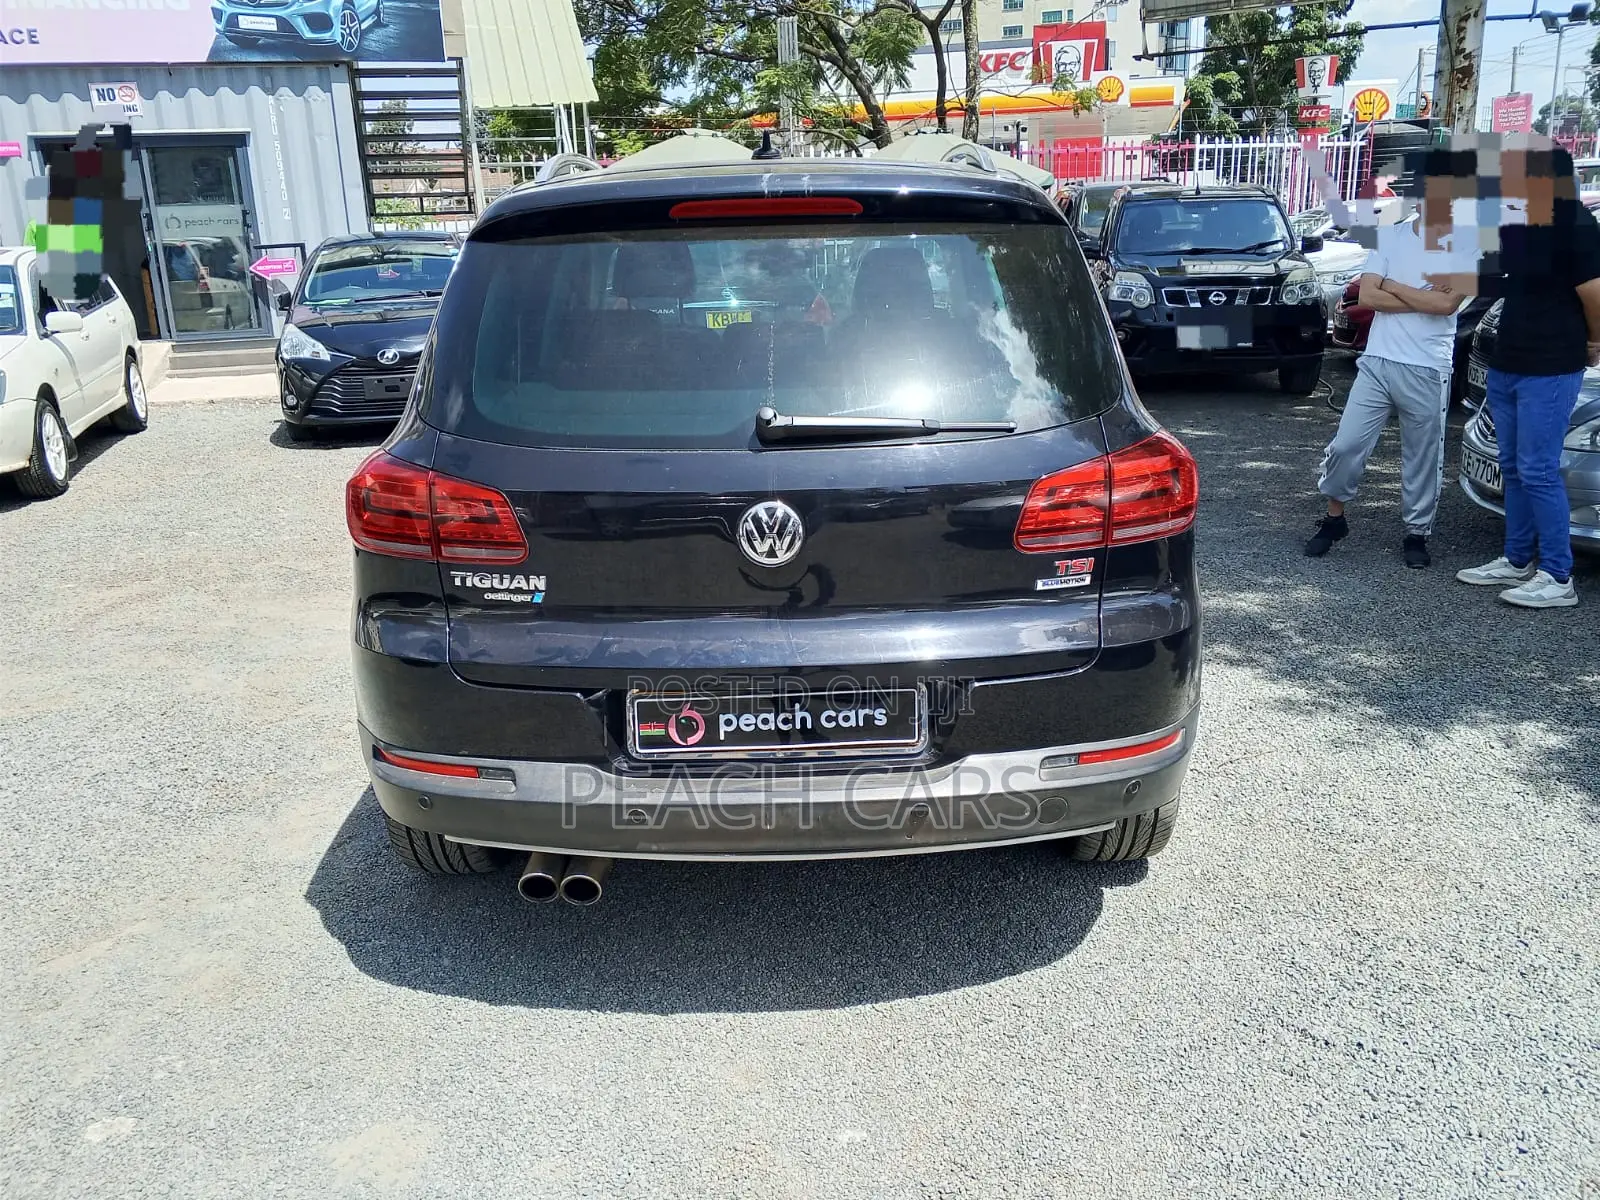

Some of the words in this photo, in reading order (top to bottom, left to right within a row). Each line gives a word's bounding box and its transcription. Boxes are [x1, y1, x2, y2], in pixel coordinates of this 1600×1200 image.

[979, 51, 1027, 73] KFC
[95, 87, 117, 102] NO
[1301, 108, 1328, 118] KFC
[184, 217, 215, 229] peach
[1474, 457, 1502, 488] 770M
[1054, 557, 1095, 576] TSI
[450, 571, 547, 590] TIGUAN
[484, 591, 532, 602] oettinger
[718, 702, 813, 741] peach
[820, 706, 888, 728] cars
